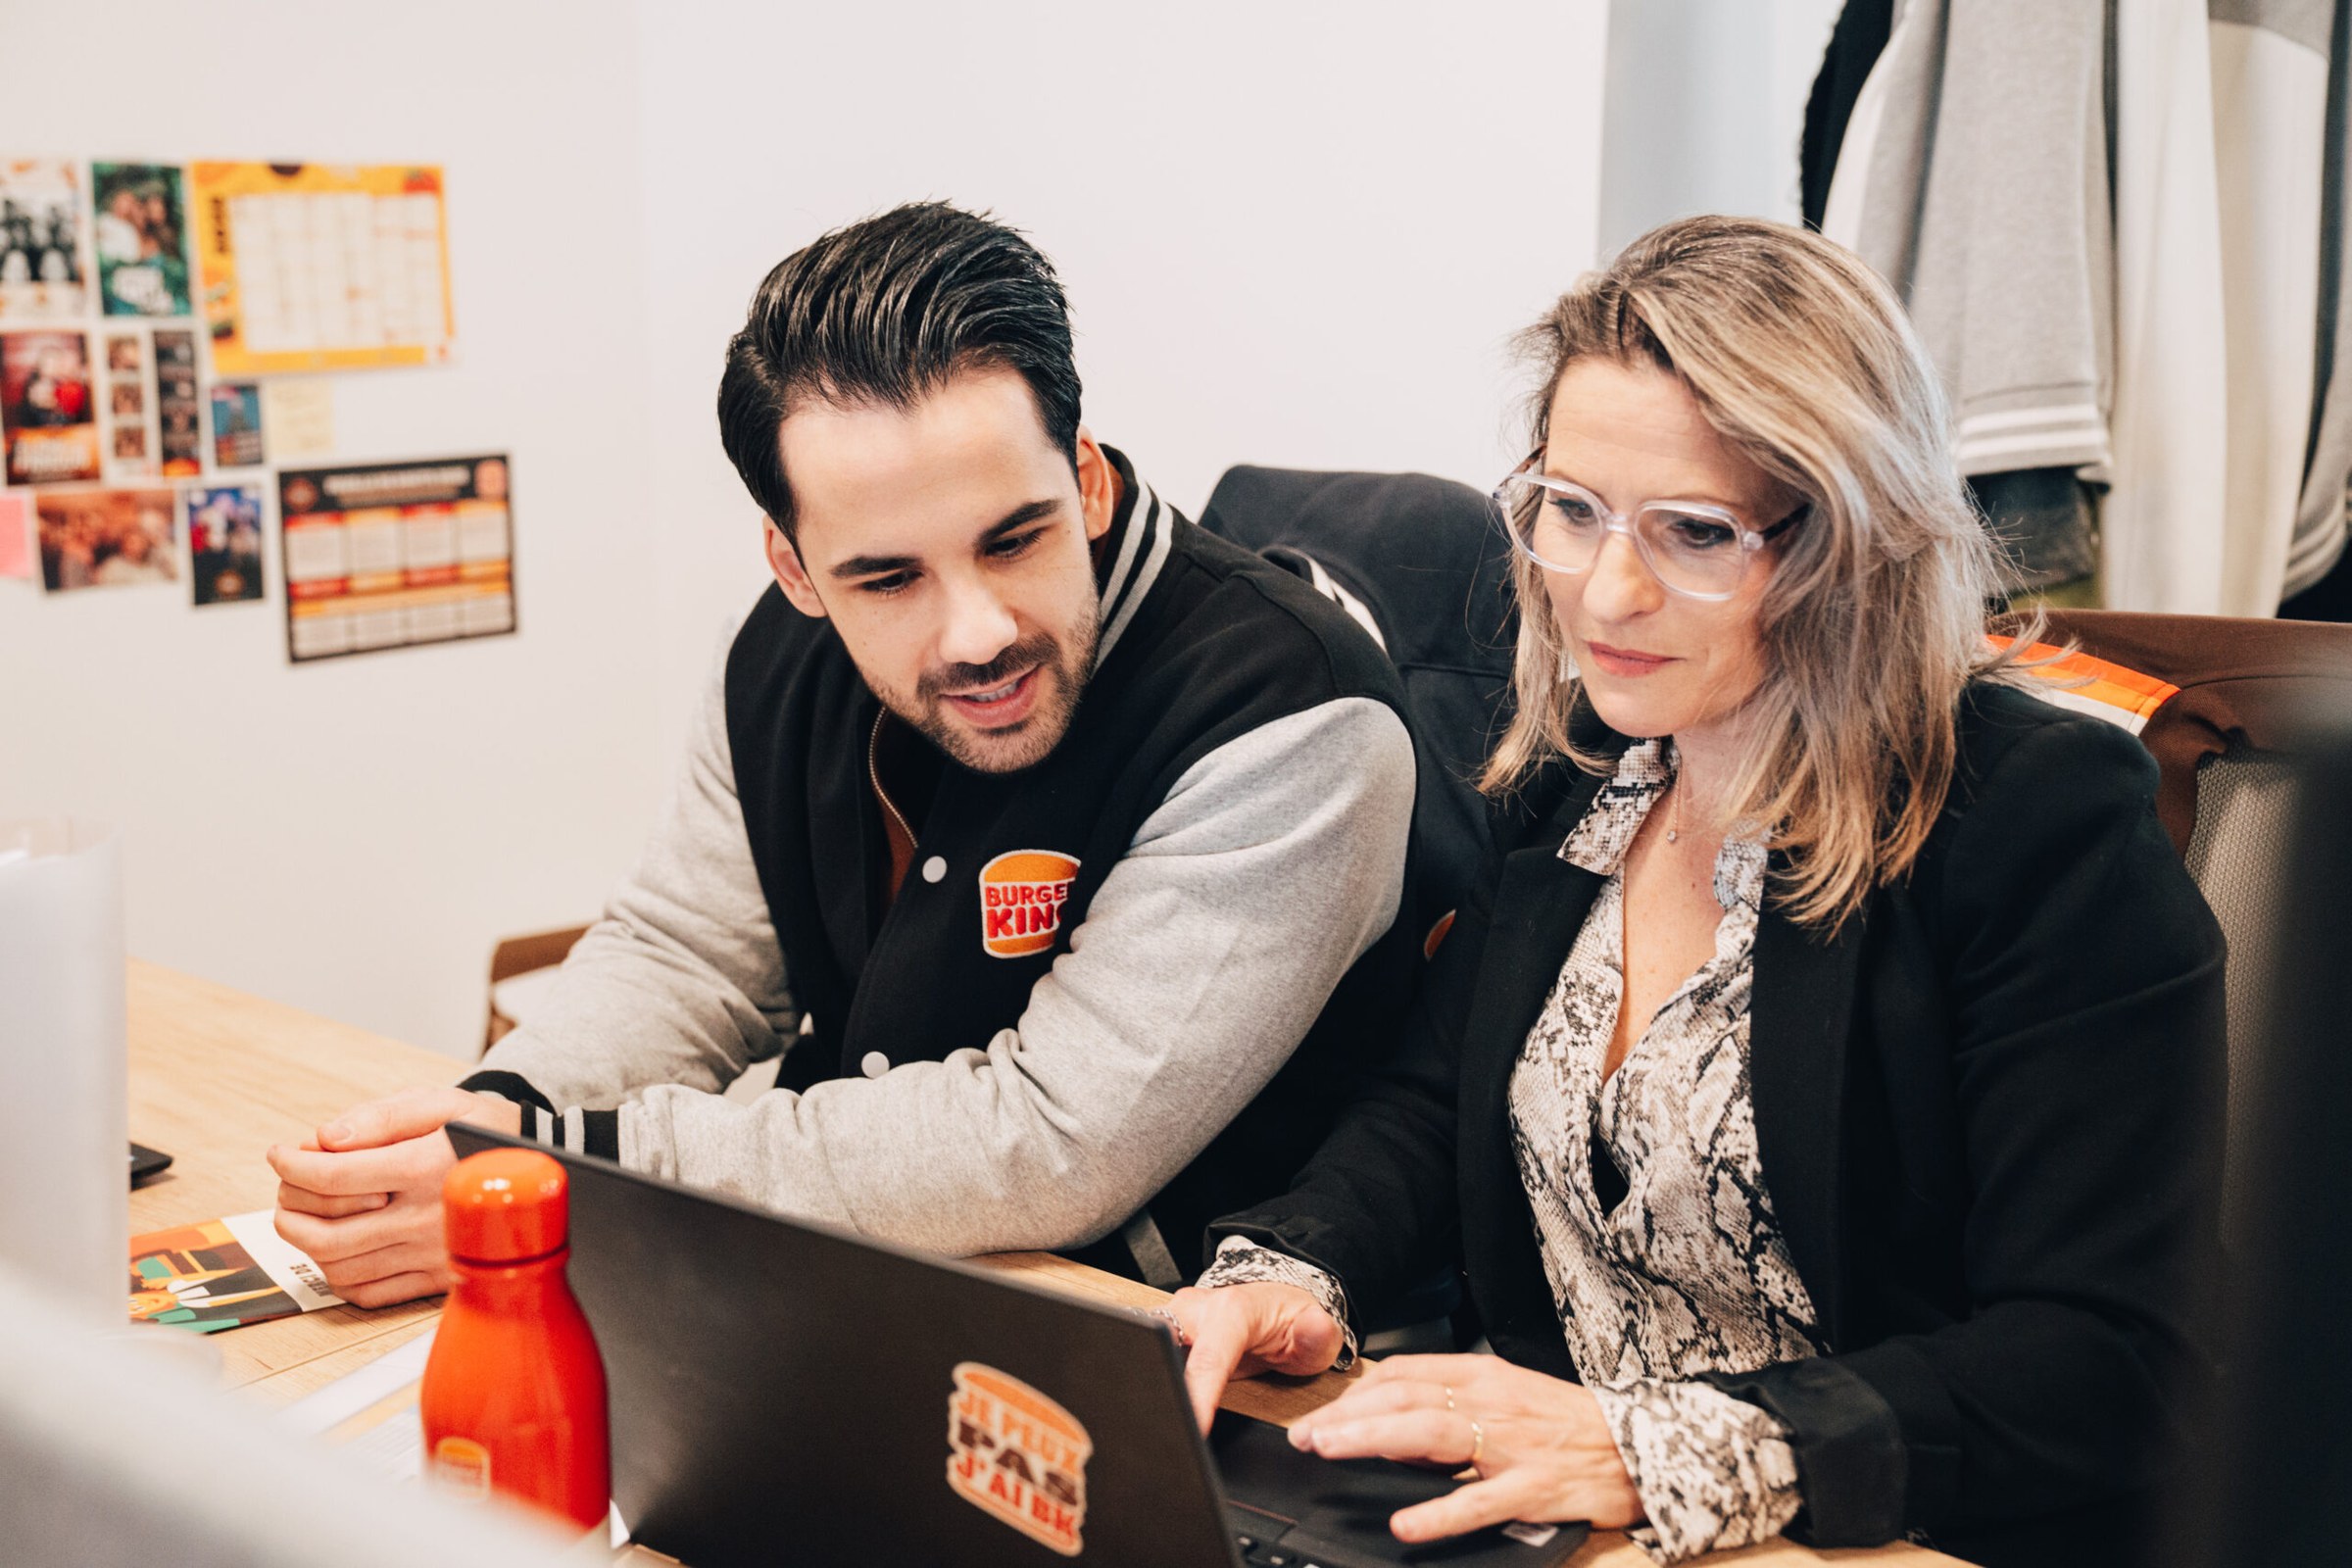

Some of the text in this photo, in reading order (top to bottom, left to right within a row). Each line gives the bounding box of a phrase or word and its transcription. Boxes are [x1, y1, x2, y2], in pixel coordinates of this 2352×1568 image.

[985, 884, 1067, 907] BURGE
[986, 904, 1061, 938] KIN
[1032, 1493, 1075, 1538] BK
